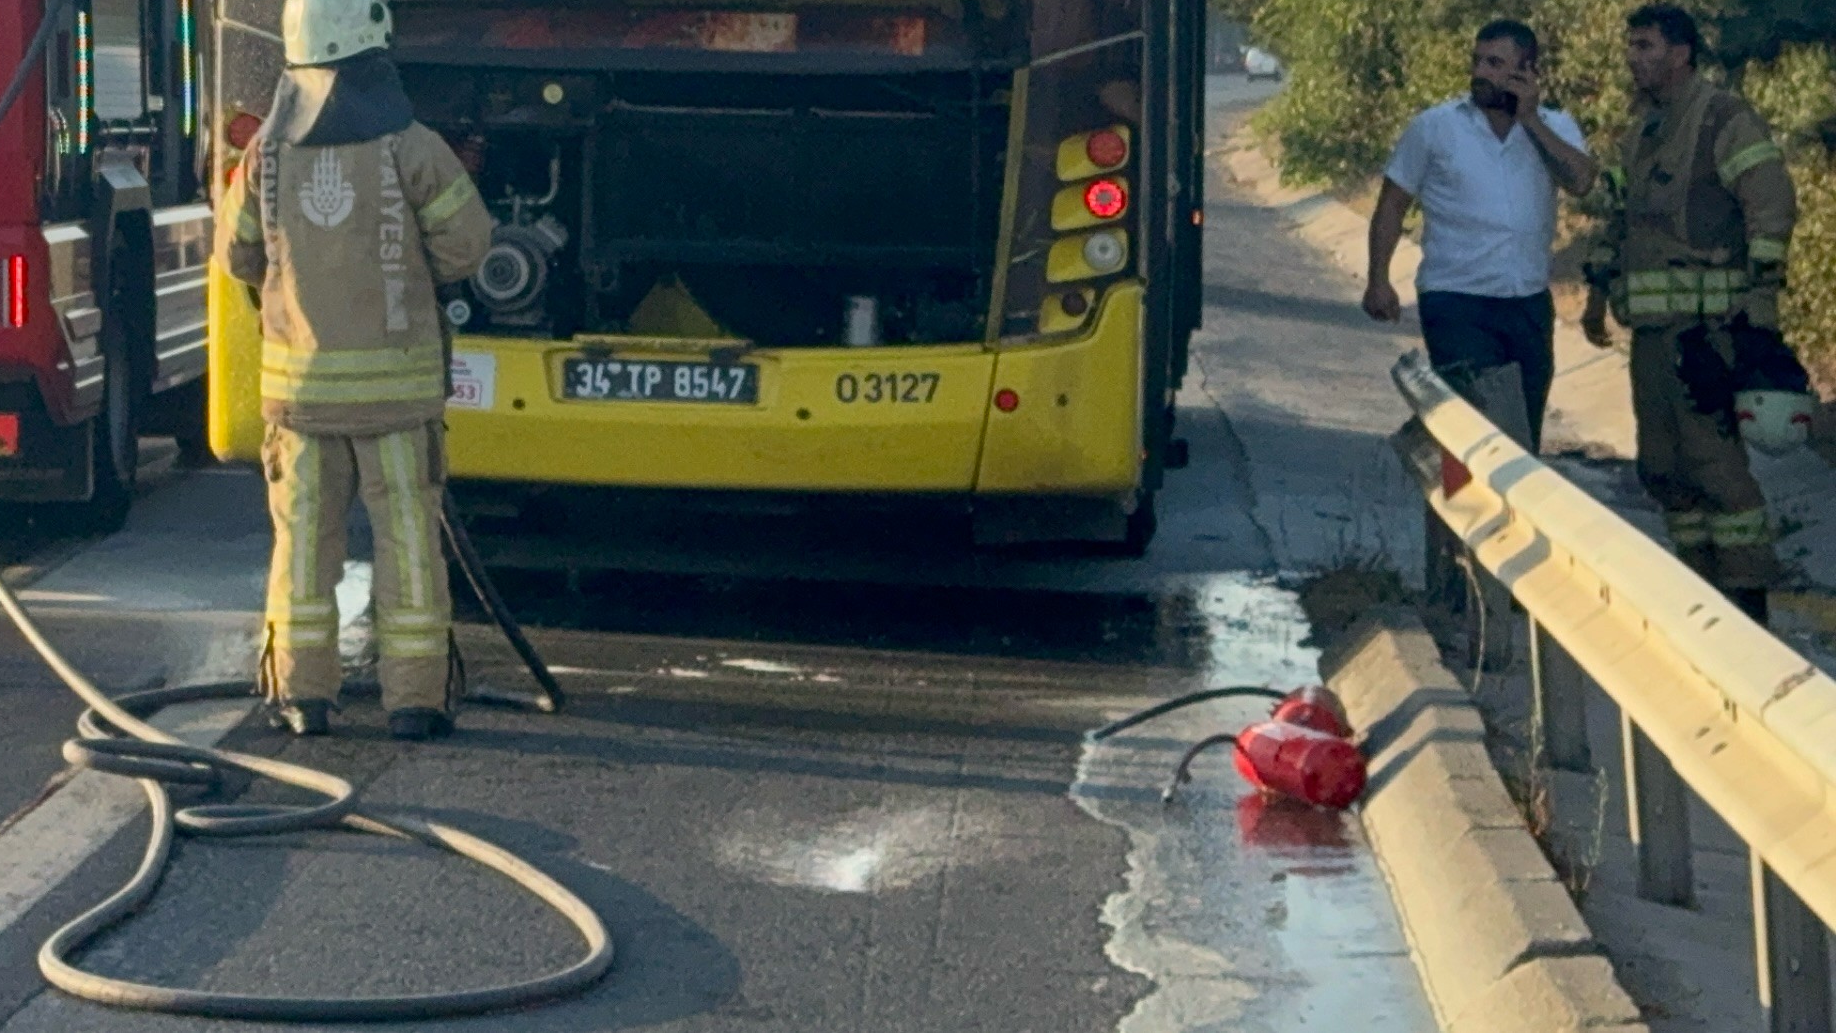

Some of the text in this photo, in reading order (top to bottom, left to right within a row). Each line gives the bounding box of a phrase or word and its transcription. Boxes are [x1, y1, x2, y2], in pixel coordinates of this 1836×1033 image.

[575, 363, 746, 400] 34 TP 8547
